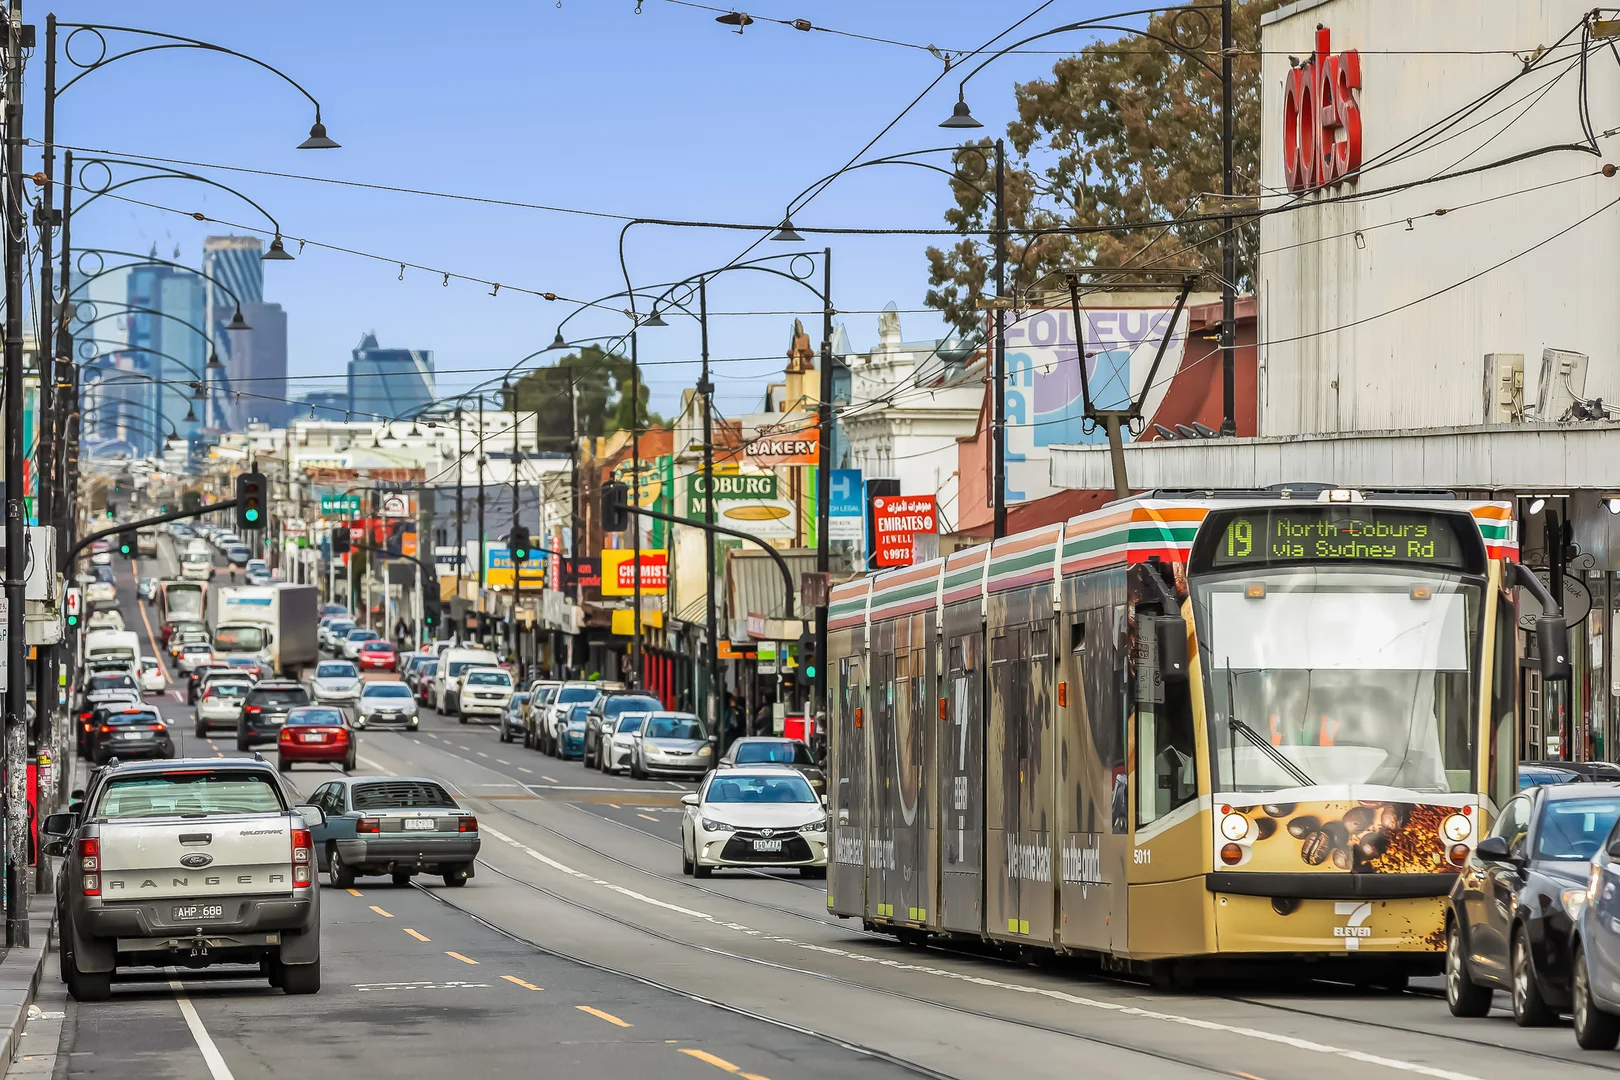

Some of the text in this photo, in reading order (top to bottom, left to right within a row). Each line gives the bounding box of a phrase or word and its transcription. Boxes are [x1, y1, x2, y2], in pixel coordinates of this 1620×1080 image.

[1283, 27, 1363, 194] coles
[746, 440, 818, 456] BAKERY
[694, 476, 771, 494] COBURG
[878, 516, 923, 532] EMIRATES
[1277, 520, 1428, 537] North Coburg
[1227, 519, 1252, 557] 19
[890, 548, 910, 559] 9973
[1272, 540, 1435, 557] via Sydney Rd
[619, 564, 668, 577] CHMIST
[189, 856, 204, 864] Ford
[1133, 848, 1151, 864] 5011
[109, 874, 285, 890] RANGER
